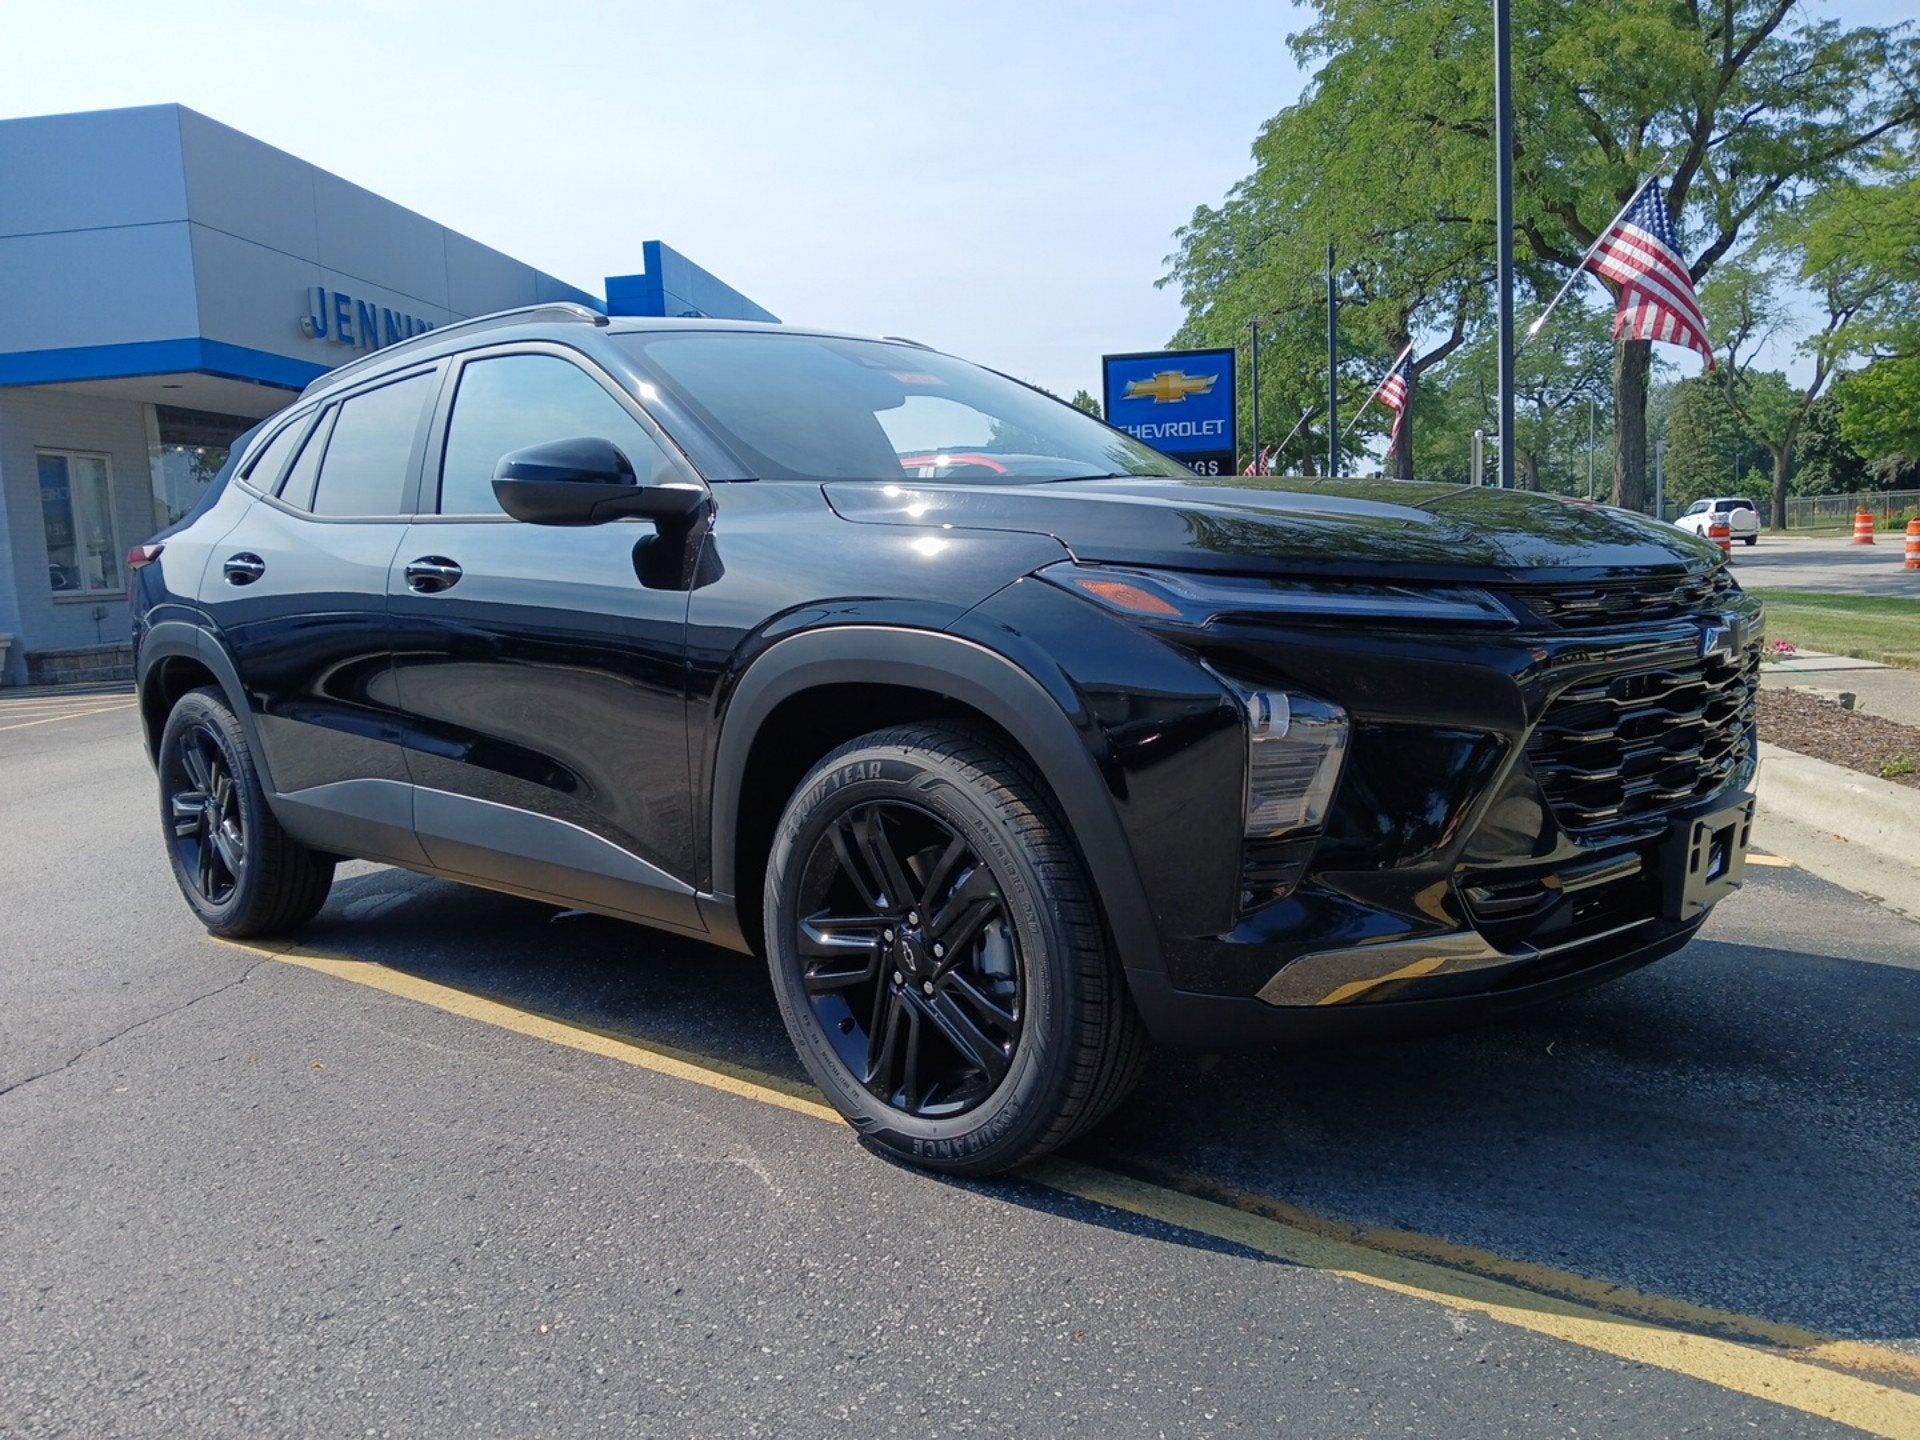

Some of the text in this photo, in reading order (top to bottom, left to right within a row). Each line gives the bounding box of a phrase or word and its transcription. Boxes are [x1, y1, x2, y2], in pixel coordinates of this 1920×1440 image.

[1118, 420, 1225, 438] HEVROLET
[1187, 461, 1219, 475] GS
[912, 1095, 1019, 1158] ASSURANCE
